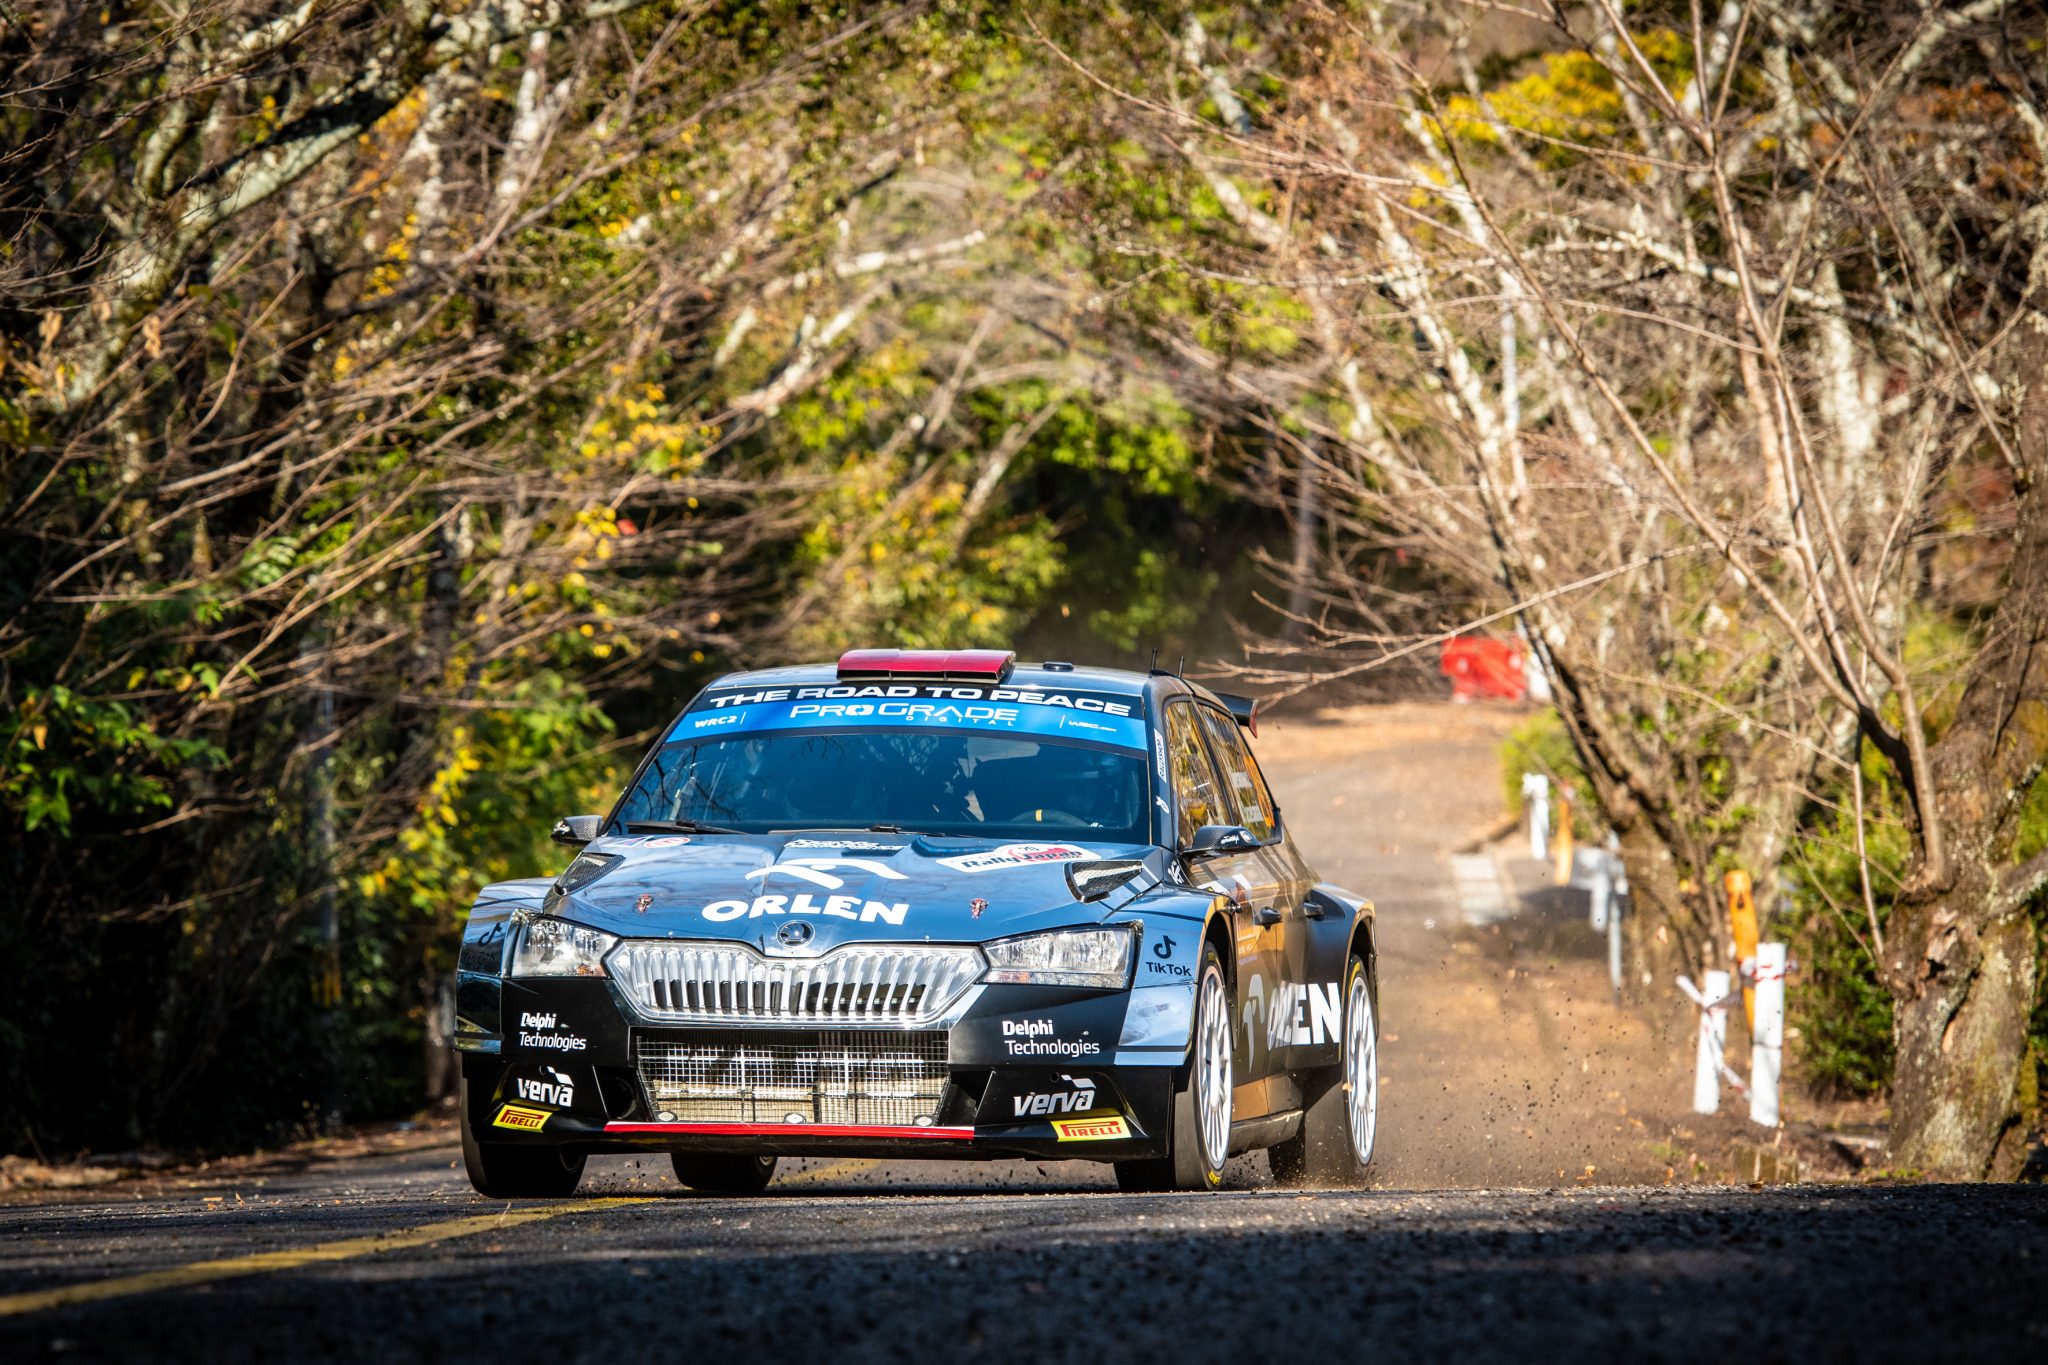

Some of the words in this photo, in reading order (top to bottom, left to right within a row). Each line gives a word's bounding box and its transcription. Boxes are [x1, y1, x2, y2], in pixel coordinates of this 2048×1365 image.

[710, 690, 791, 708] THE
[797, 686, 917, 699] ROAD
[925, 686, 983, 699] TO
[990, 690, 1132, 717] PEACE
[695, 715, 737, 728] WRC2
[905, 716, 1014, 727] DIGITAL
[961, 855, 1021, 868] Rally
[1021, 849, 1084, 861] Japan
[702, 895, 910, 925] ORLEN
[1145, 961, 1193, 977] TikTok
[521, 1012, 557, 1030] Delphi
[1002, 1020, 1054, 1038] Delphi
[519, 1031, 587, 1051] Technologies
[1004, 1039, 1100, 1058] Technologies
[517, 1078, 574, 1107] verva
[1014, 1089, 1095, 1117] verva
[500, 1110, 544, 1128] PIRELLI
[1060, 1121, 1121, 1138] PIRELLI
